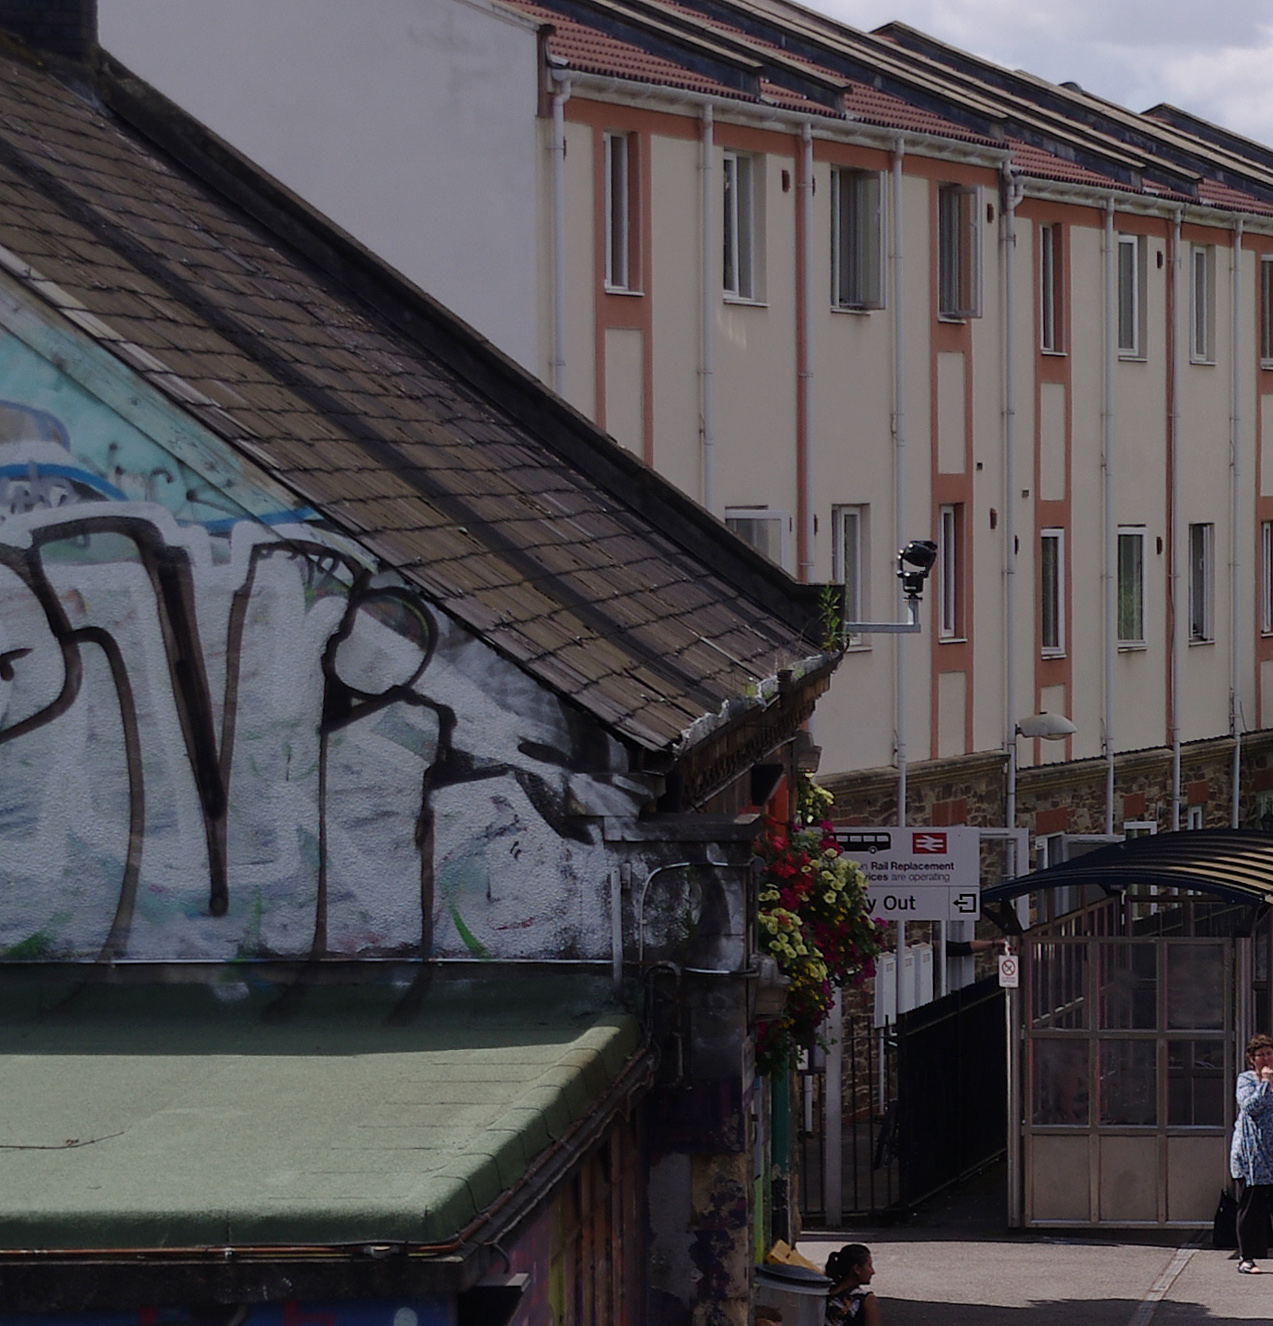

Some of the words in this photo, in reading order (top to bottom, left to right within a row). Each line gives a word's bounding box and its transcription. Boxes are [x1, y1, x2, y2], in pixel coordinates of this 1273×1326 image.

[871, 862, 888, 870] Rail
[891, 862, 954, 872] Replacement
[909, 873, 950, 883] operating
[884, 895, 916, 911] Out
